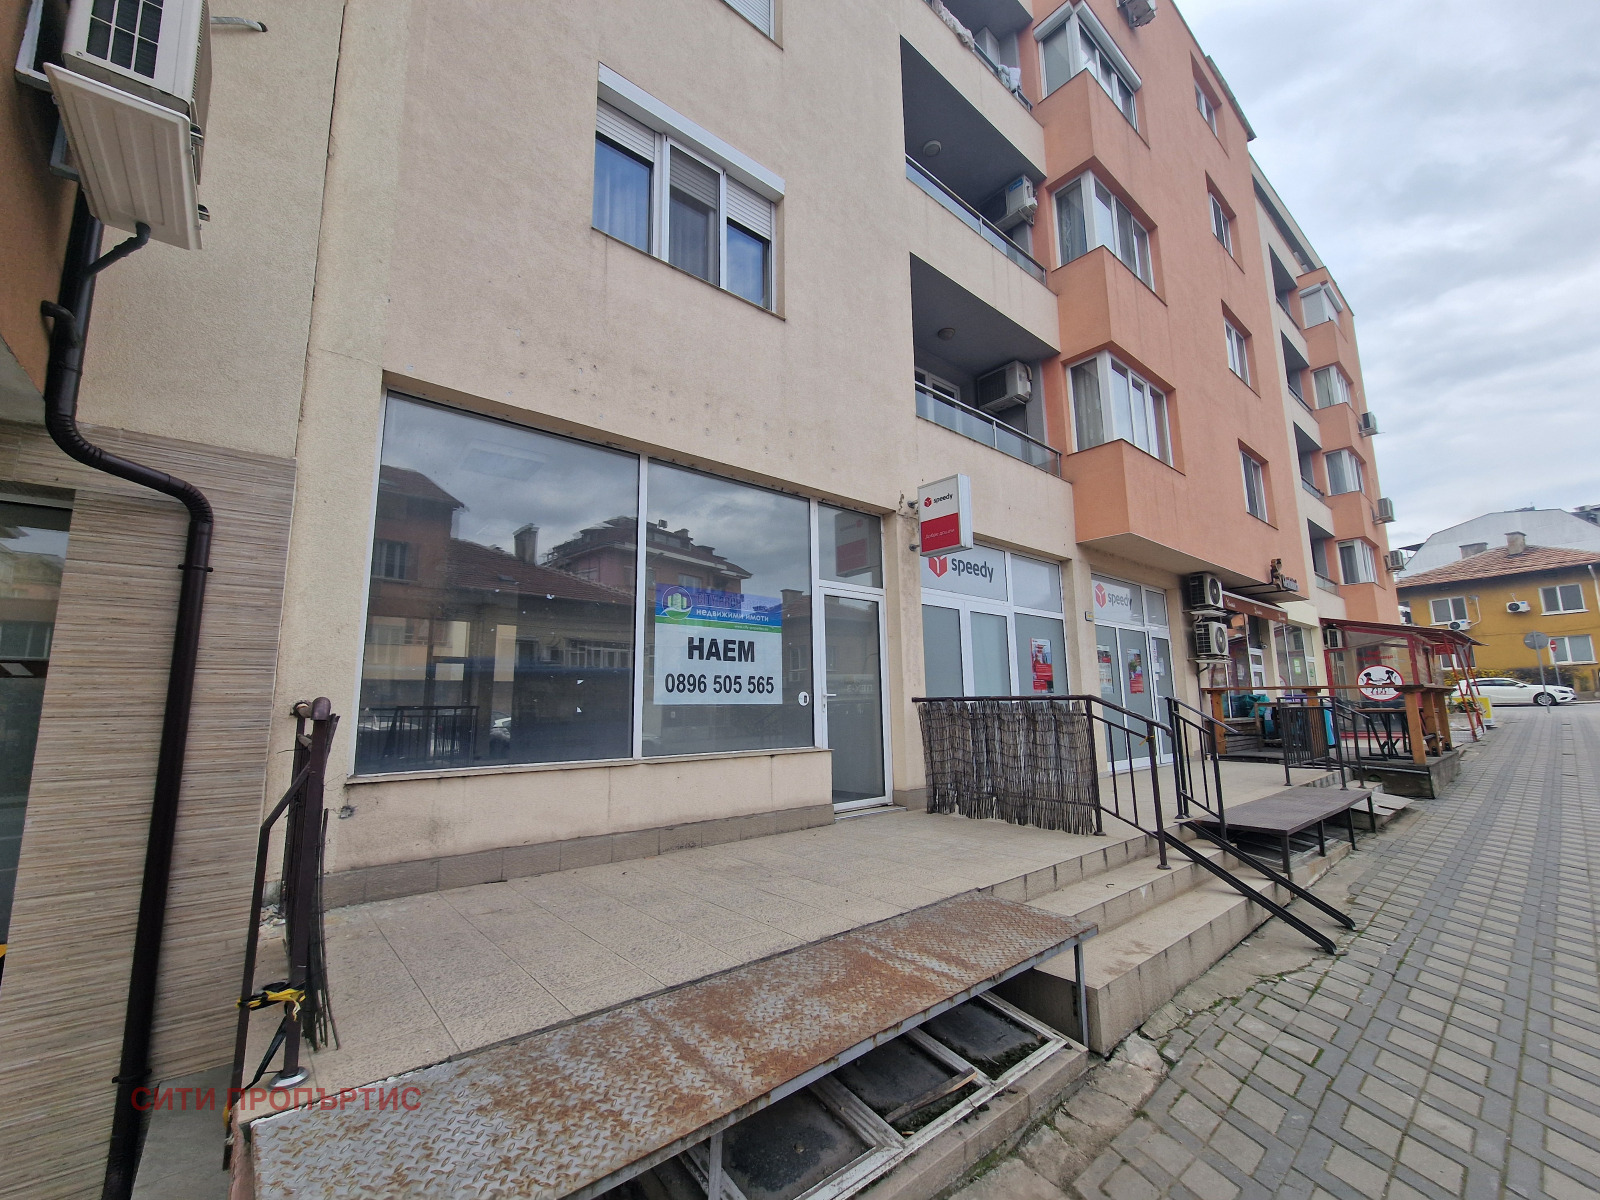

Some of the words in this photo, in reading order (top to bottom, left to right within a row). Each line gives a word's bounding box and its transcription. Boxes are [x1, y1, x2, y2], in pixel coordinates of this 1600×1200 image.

[933, 492, 954, 504] speedy
[951, 556, 994, 583] speedy
[697, 592, 716, 606] CITY
[1107, 591, 1132, 611] speedy
[696, 609, 743, 619] недвижими
[745, 614, 769, 622] имоти
[687, 636, 755, 663] НАЕМ
[665, 673, 707, 694] 0896
[713, 674, 743, 694] 505
[747, 676, 774, 694] 565
